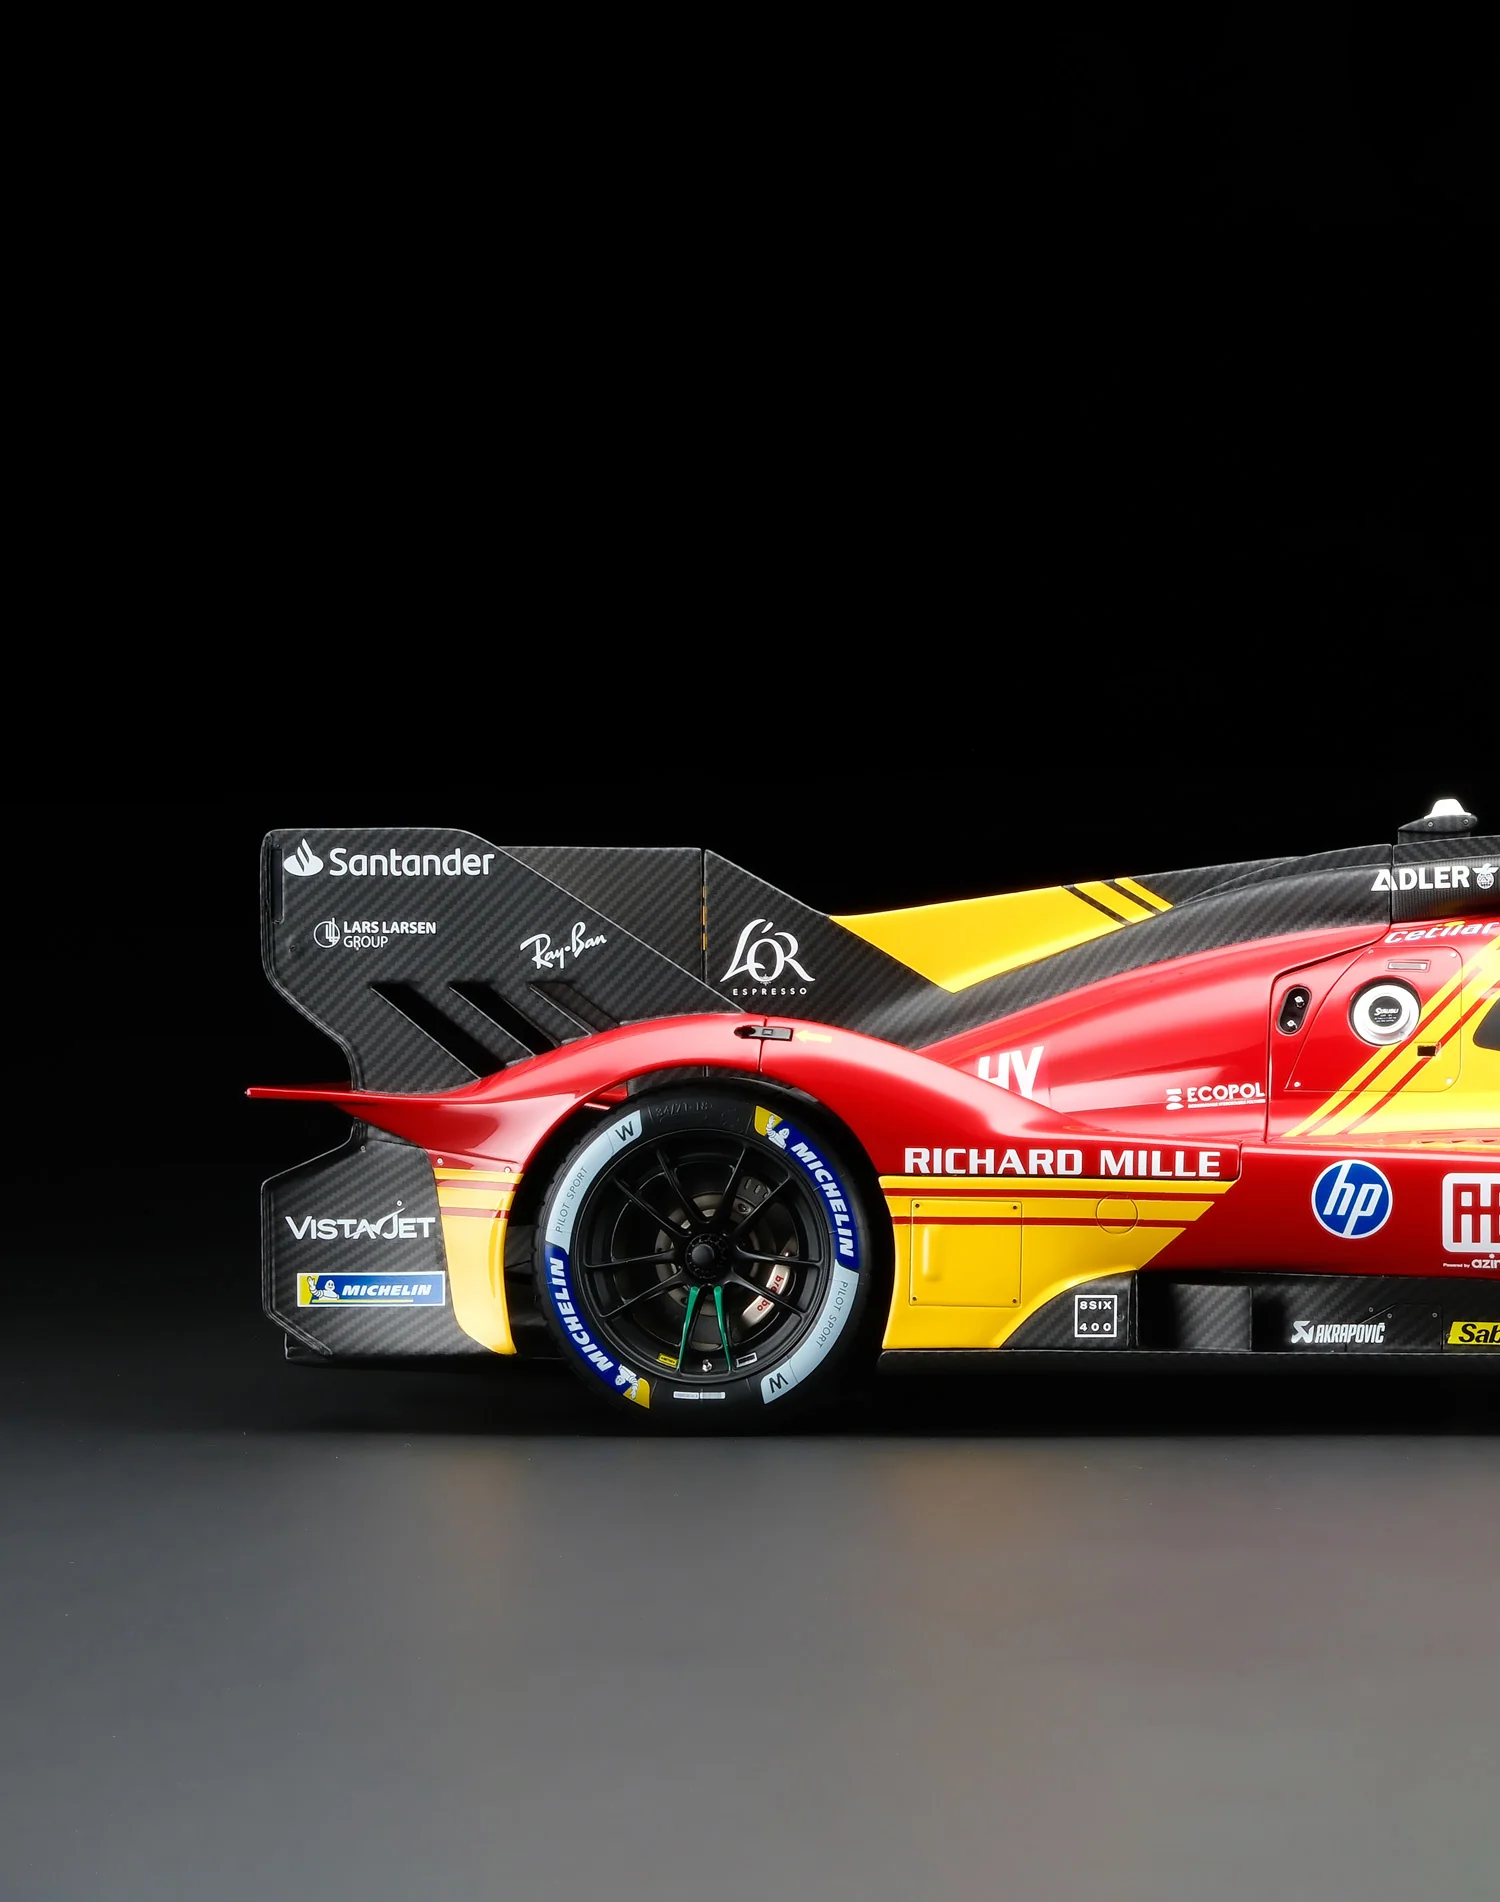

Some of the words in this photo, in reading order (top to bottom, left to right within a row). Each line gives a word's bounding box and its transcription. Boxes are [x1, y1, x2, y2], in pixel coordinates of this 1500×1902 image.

[329, 848, 495, 876] Santander
[1370, 865, 1470, 892] ADLER
[343, 921, 379, 934] LARS
[382, 921, 436, 934] LARSEN
[343, 935, 388, 948] GROUP
[732, 987, 807, 996] ESPRESSO
[1187, 1082, 1265, 1102] ECOPOL
[615, 1121, 634, 1141] W
[904, 1147, 1083, 1176] RICHARD
[1100, 1149, 1221, 1178] MILLE
[555, 1203, 570, 1233] PILOT
[567, 1167, 588, 1199] SPORT
[790, 1142, 854, 1257] MICHELIN
[1323, 1161, 1383, 1237] hp
[341, 1281, 432, 1297] MICHELIN
[757, 1275, 785, 1311] brebo
[834, 1281, 848, 1312] PILOT
[550, 1257, 614, 1371] MICHELIN
[1079, 1300, 1112, 1310] 8SIX
[816, 1314, 837, 1348] SPORT
[1079, 1322, 1112, 1332] 400
[768, 1372, 789, 1394] W
